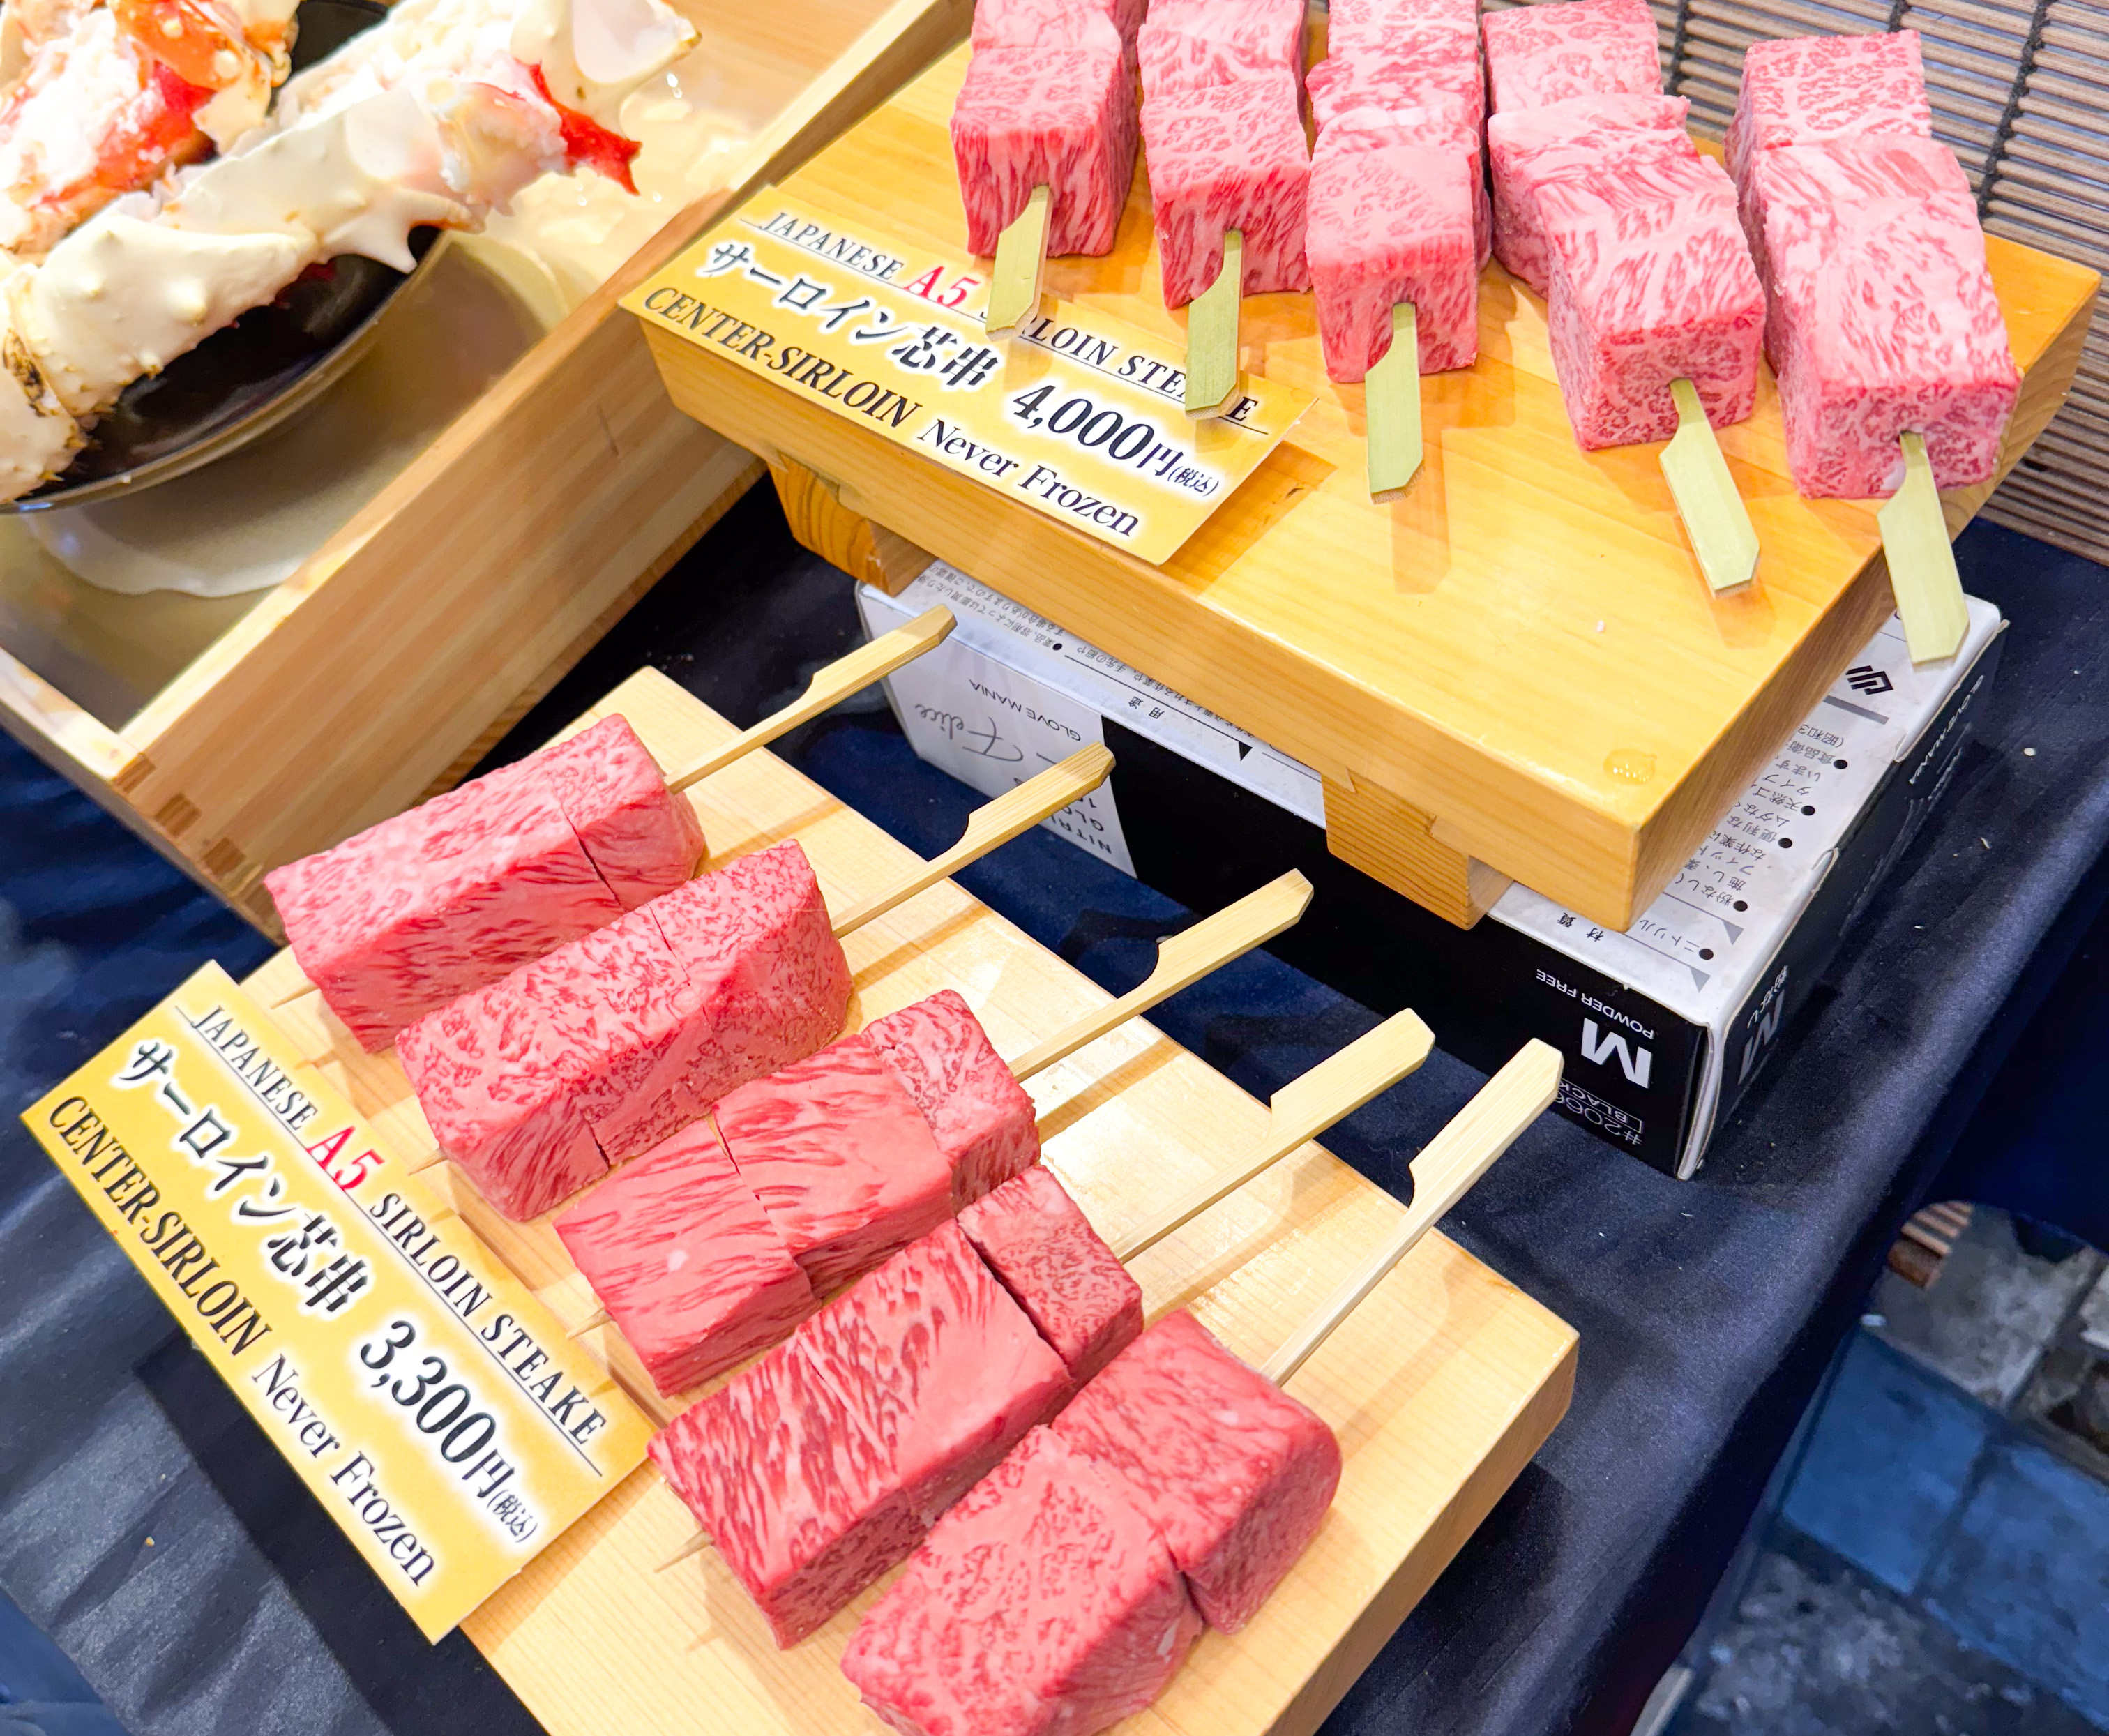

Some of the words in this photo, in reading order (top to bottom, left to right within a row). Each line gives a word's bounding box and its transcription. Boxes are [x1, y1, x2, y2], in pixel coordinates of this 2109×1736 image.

[702, 242, 998, 386] サーロイン芯串
[759, 212, 905, 280] JAPANESE
[904, 265, 981, 308] A5
[979, 311, 1119, 365] LOIN
[1117, 355, 1259, 422] STEE
[644, 287, 923, 428] CENTER-SIRLOIN
[918, 418, 1019, 478] Never
[1018, 465, 1139, 537] Frozen
[969, 679, 1022, 713] MANIA
[1128, 696, 1165, 719] 用途
[914, 703, 1023, 762] Felice
[1027, 707, 1081, 741] GLOVE
[1787, 741, 1836, 764] 食品衛
[1763, 773, 1811, 796] タイプ
[1727, 815, 1778, 843] 便利な
[1734, 801, 1790, 828] ムダなく
[1050, 814, 1112, 854] NITRI
[1699, 845, 1755, 876] フィット
[1557, 912, 1604, 942] 材質
[1640, 919, 1700, 952] ニトリル
[1536, 969, 1577, 998] FREE
[1581, 992, 1655, 1040] POWDER
[1580, 1017, 1652, 1089] M
[119, 1039, 371, 1315] サーロイン芯串
[191, 1004, 319, 1131] JAPANESE
[305, 1125, 388, 1192] A5
[369, 1193, 494, 1318] SIRLOIN
[481, 1313, 607, 1445] STEAKE
[48, 1095, 273, 1358] CENTER-SIRLOIN
[250, 1352, 341, 1460] Never
[329, 1449, 437, 1587] Frozen
